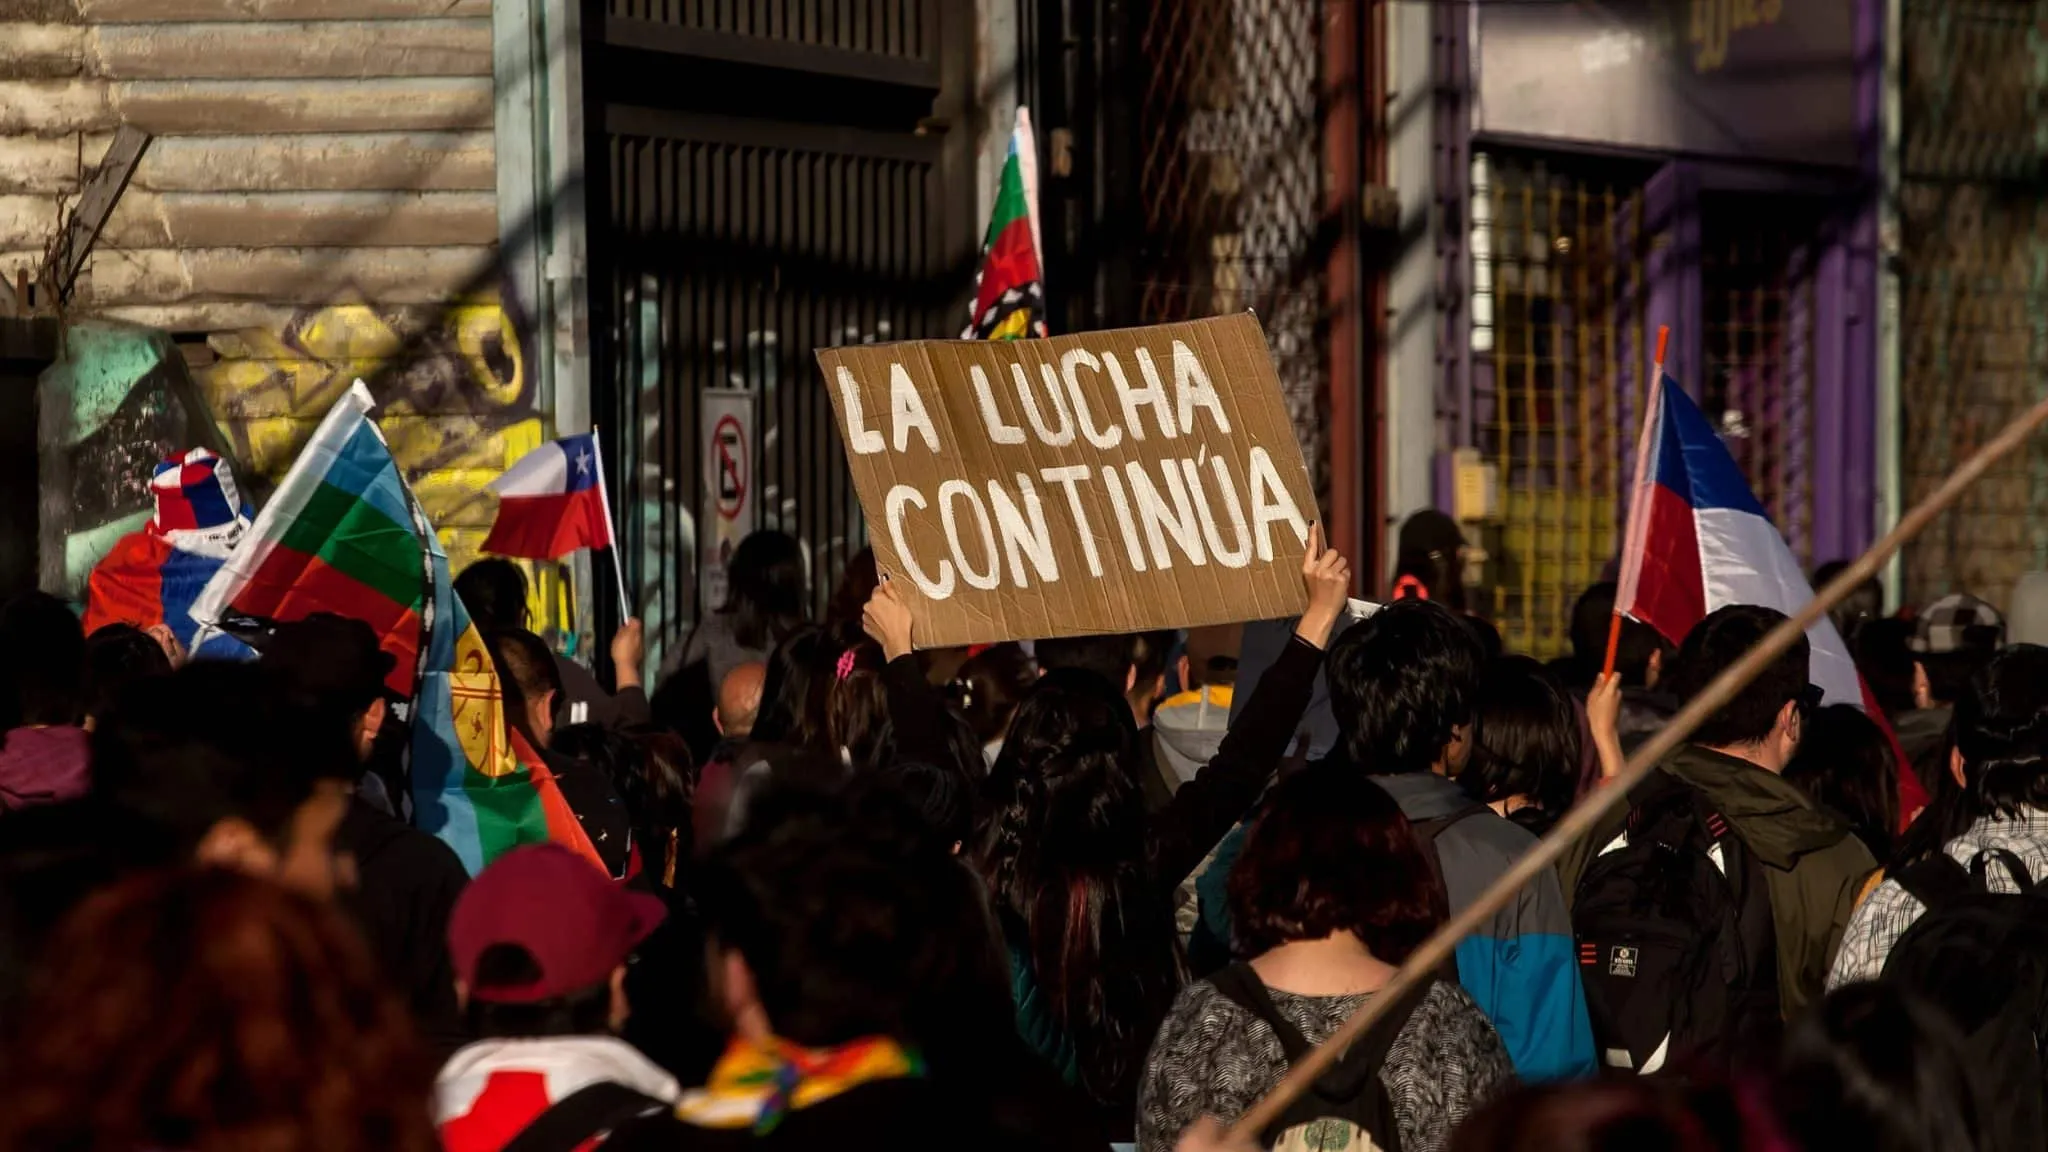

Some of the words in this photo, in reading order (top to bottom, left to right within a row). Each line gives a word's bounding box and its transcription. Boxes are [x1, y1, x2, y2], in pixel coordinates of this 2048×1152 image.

[836, 362, 941, 455] LA
[970, 339, 1232, 450] LUCHA
[884, 442, 1310, 601] CONTINÚA
